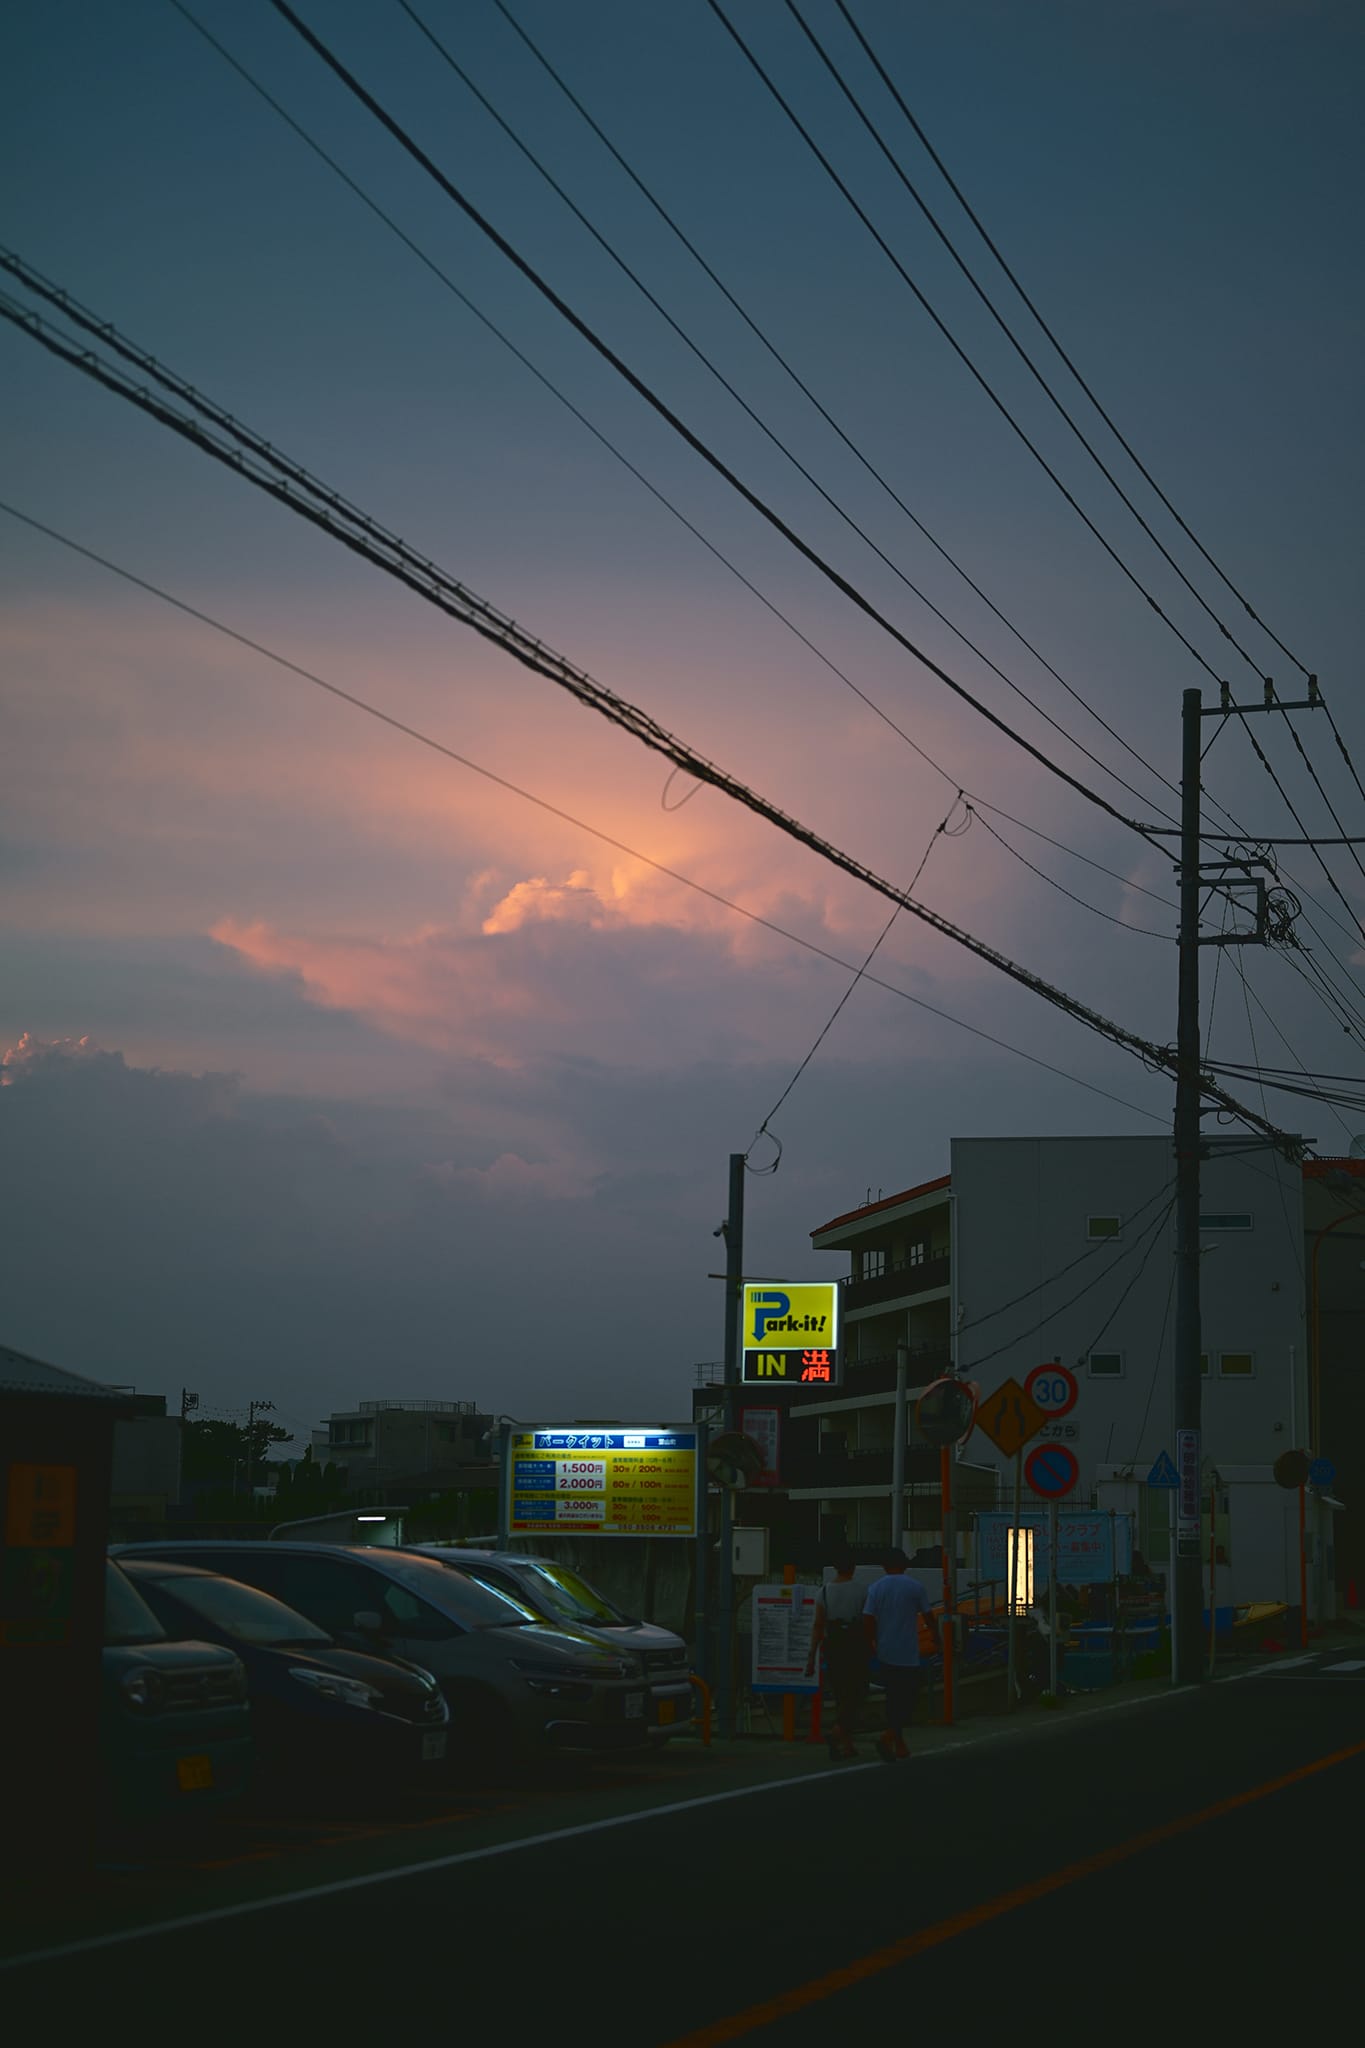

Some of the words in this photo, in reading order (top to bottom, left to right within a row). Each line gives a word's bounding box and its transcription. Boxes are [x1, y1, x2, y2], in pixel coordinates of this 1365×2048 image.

[757, 1354, 786, 1376] IN
[801, 1349, 830, 1382] 満
[1036, 1379, 1066, 1403] 30
[1040, 1424, 1076, 1437] こから
[539, 1435, 614, 1449] パークイット
